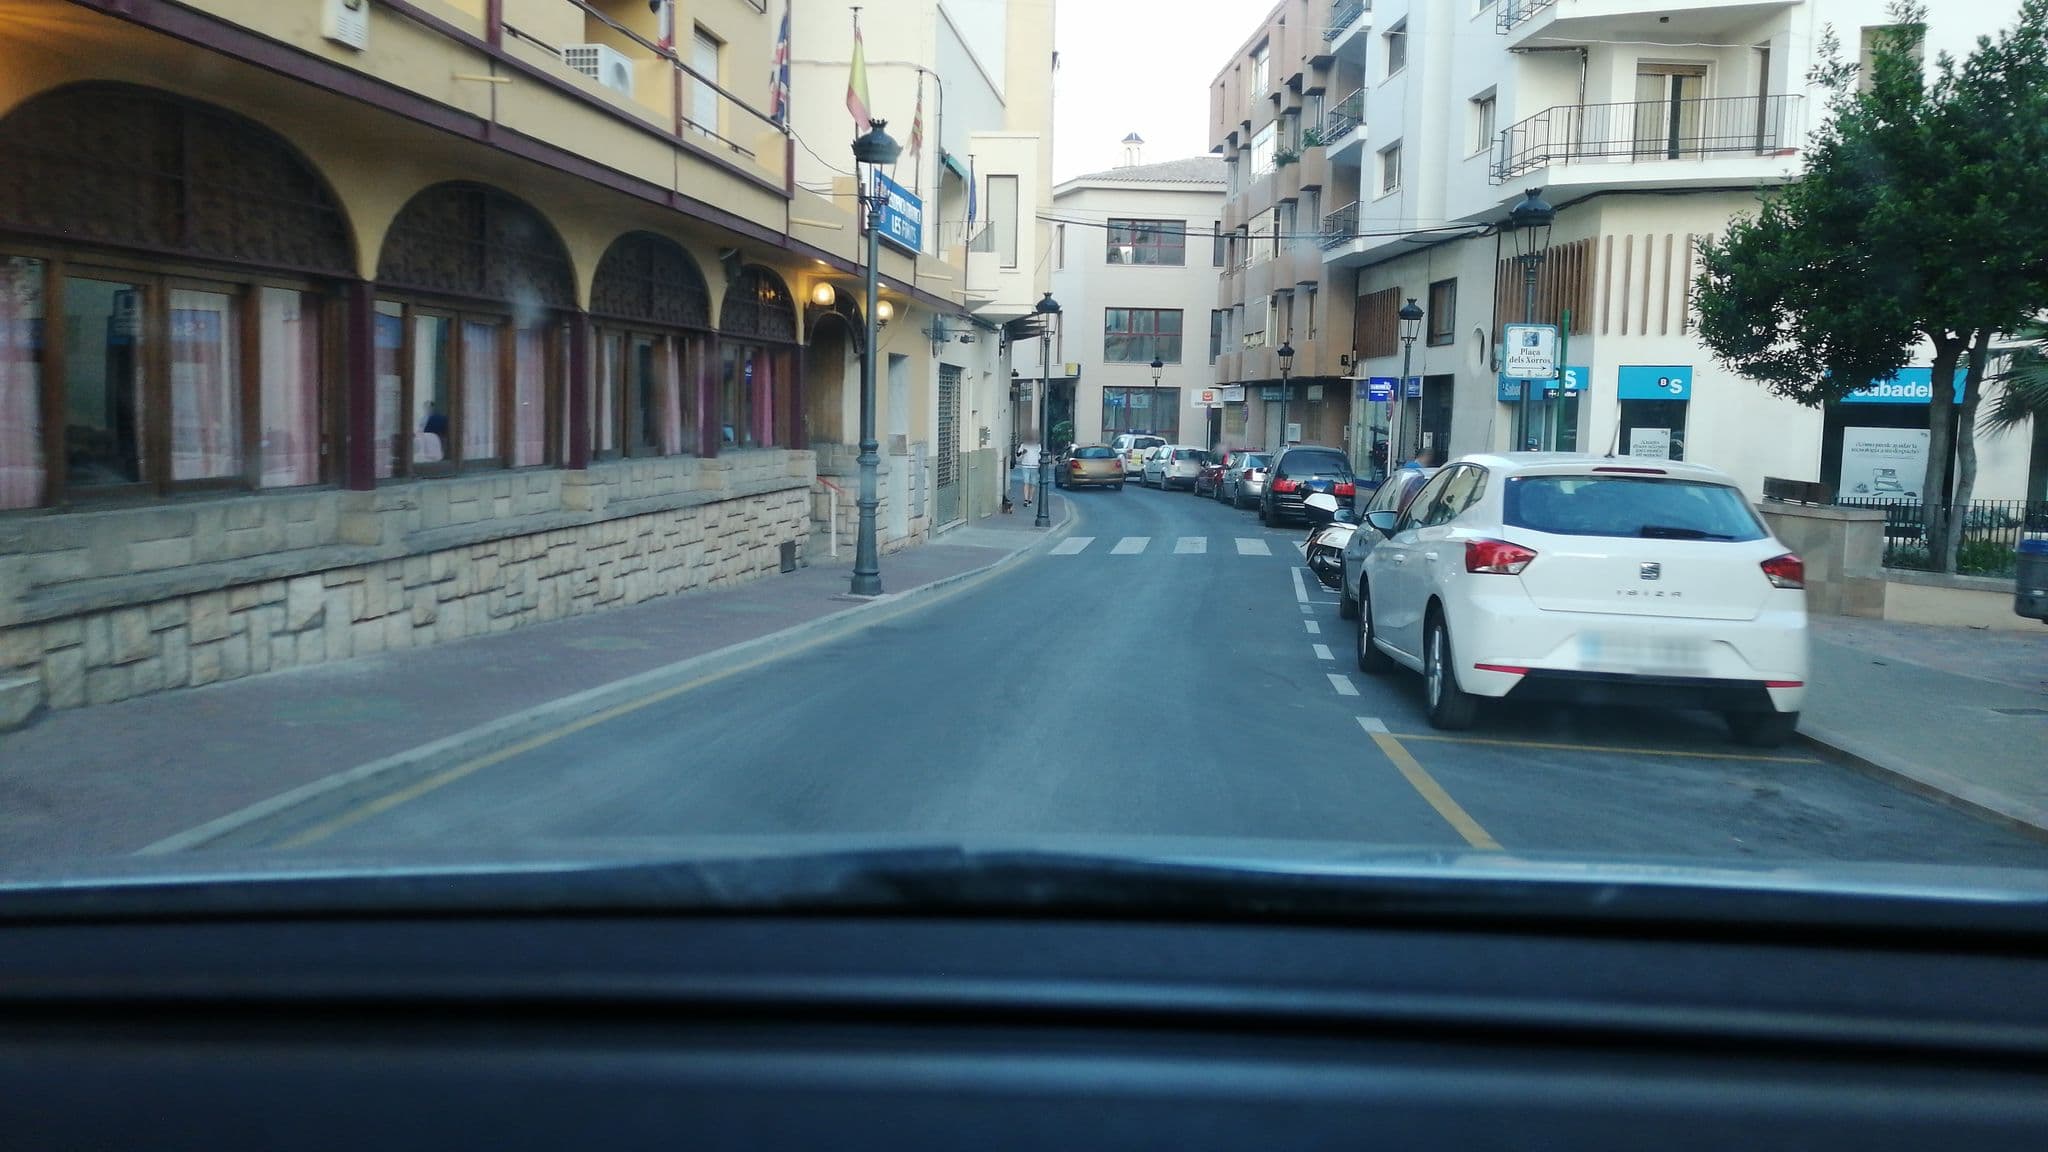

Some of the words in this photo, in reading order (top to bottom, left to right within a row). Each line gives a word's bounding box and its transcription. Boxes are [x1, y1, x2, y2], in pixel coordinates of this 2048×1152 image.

[1520, 348, 1540, 358] Plaça
[1509, 356, 1525, 364] dels
[1526, 356, 1551, 365] Xorros
[1616, 589, 1682, 598] IBIZA
